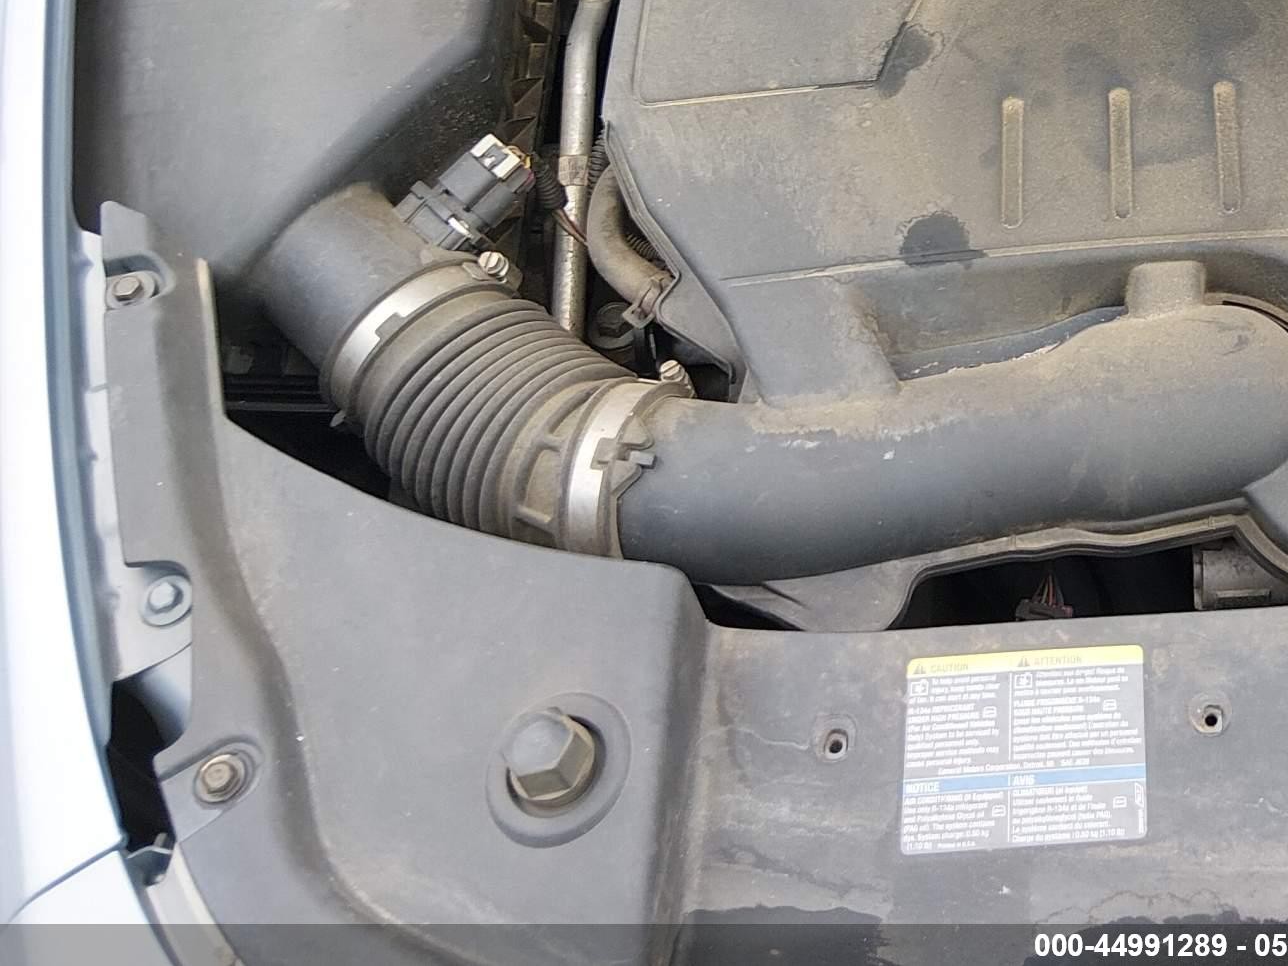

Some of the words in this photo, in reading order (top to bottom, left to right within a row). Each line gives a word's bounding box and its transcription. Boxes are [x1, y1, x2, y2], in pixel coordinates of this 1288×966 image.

[1033, 655, 1083, 666] ATTENTION
[1011, 774, 1036, 786] AVIS
[905, 781, 941, 794] NOTICE
